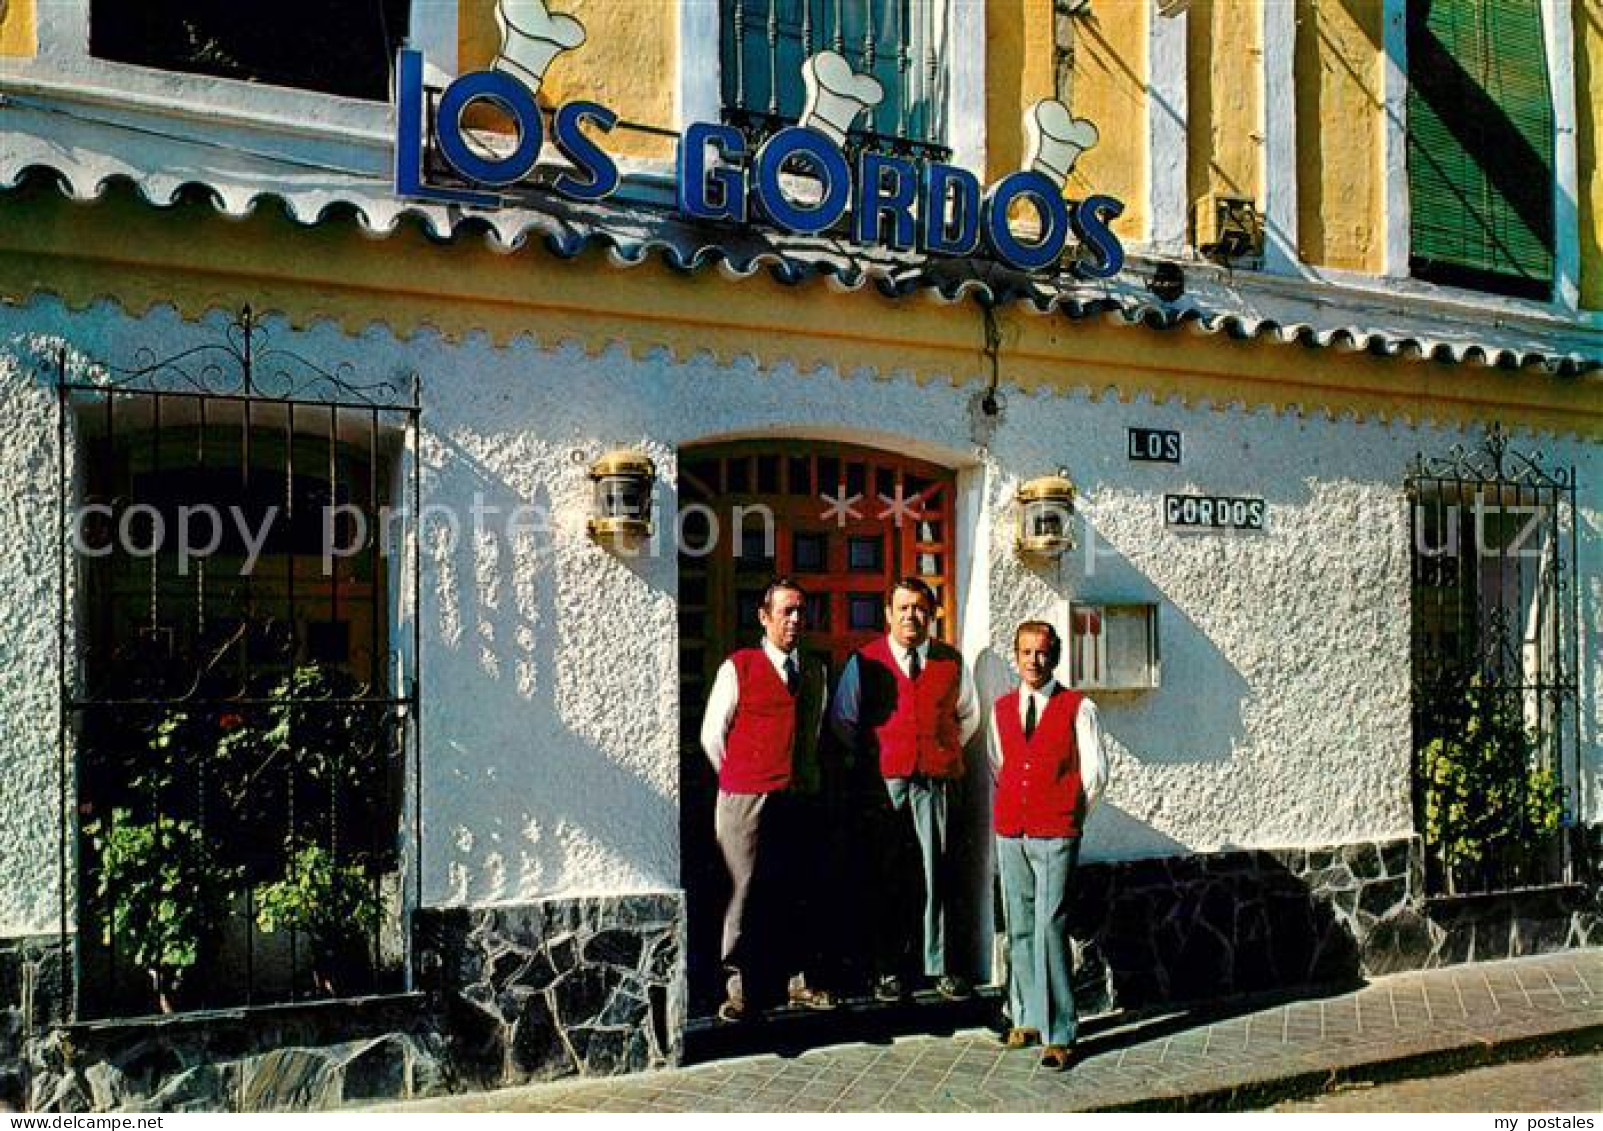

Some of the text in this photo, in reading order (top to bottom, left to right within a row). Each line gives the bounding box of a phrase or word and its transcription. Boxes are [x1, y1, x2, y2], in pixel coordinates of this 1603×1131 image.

[394, 48, 1126, 279] LOS GORDOS
[1130, 432, 1178, 459] LOS
[1167, 498, 1263, 526] GORDOS
